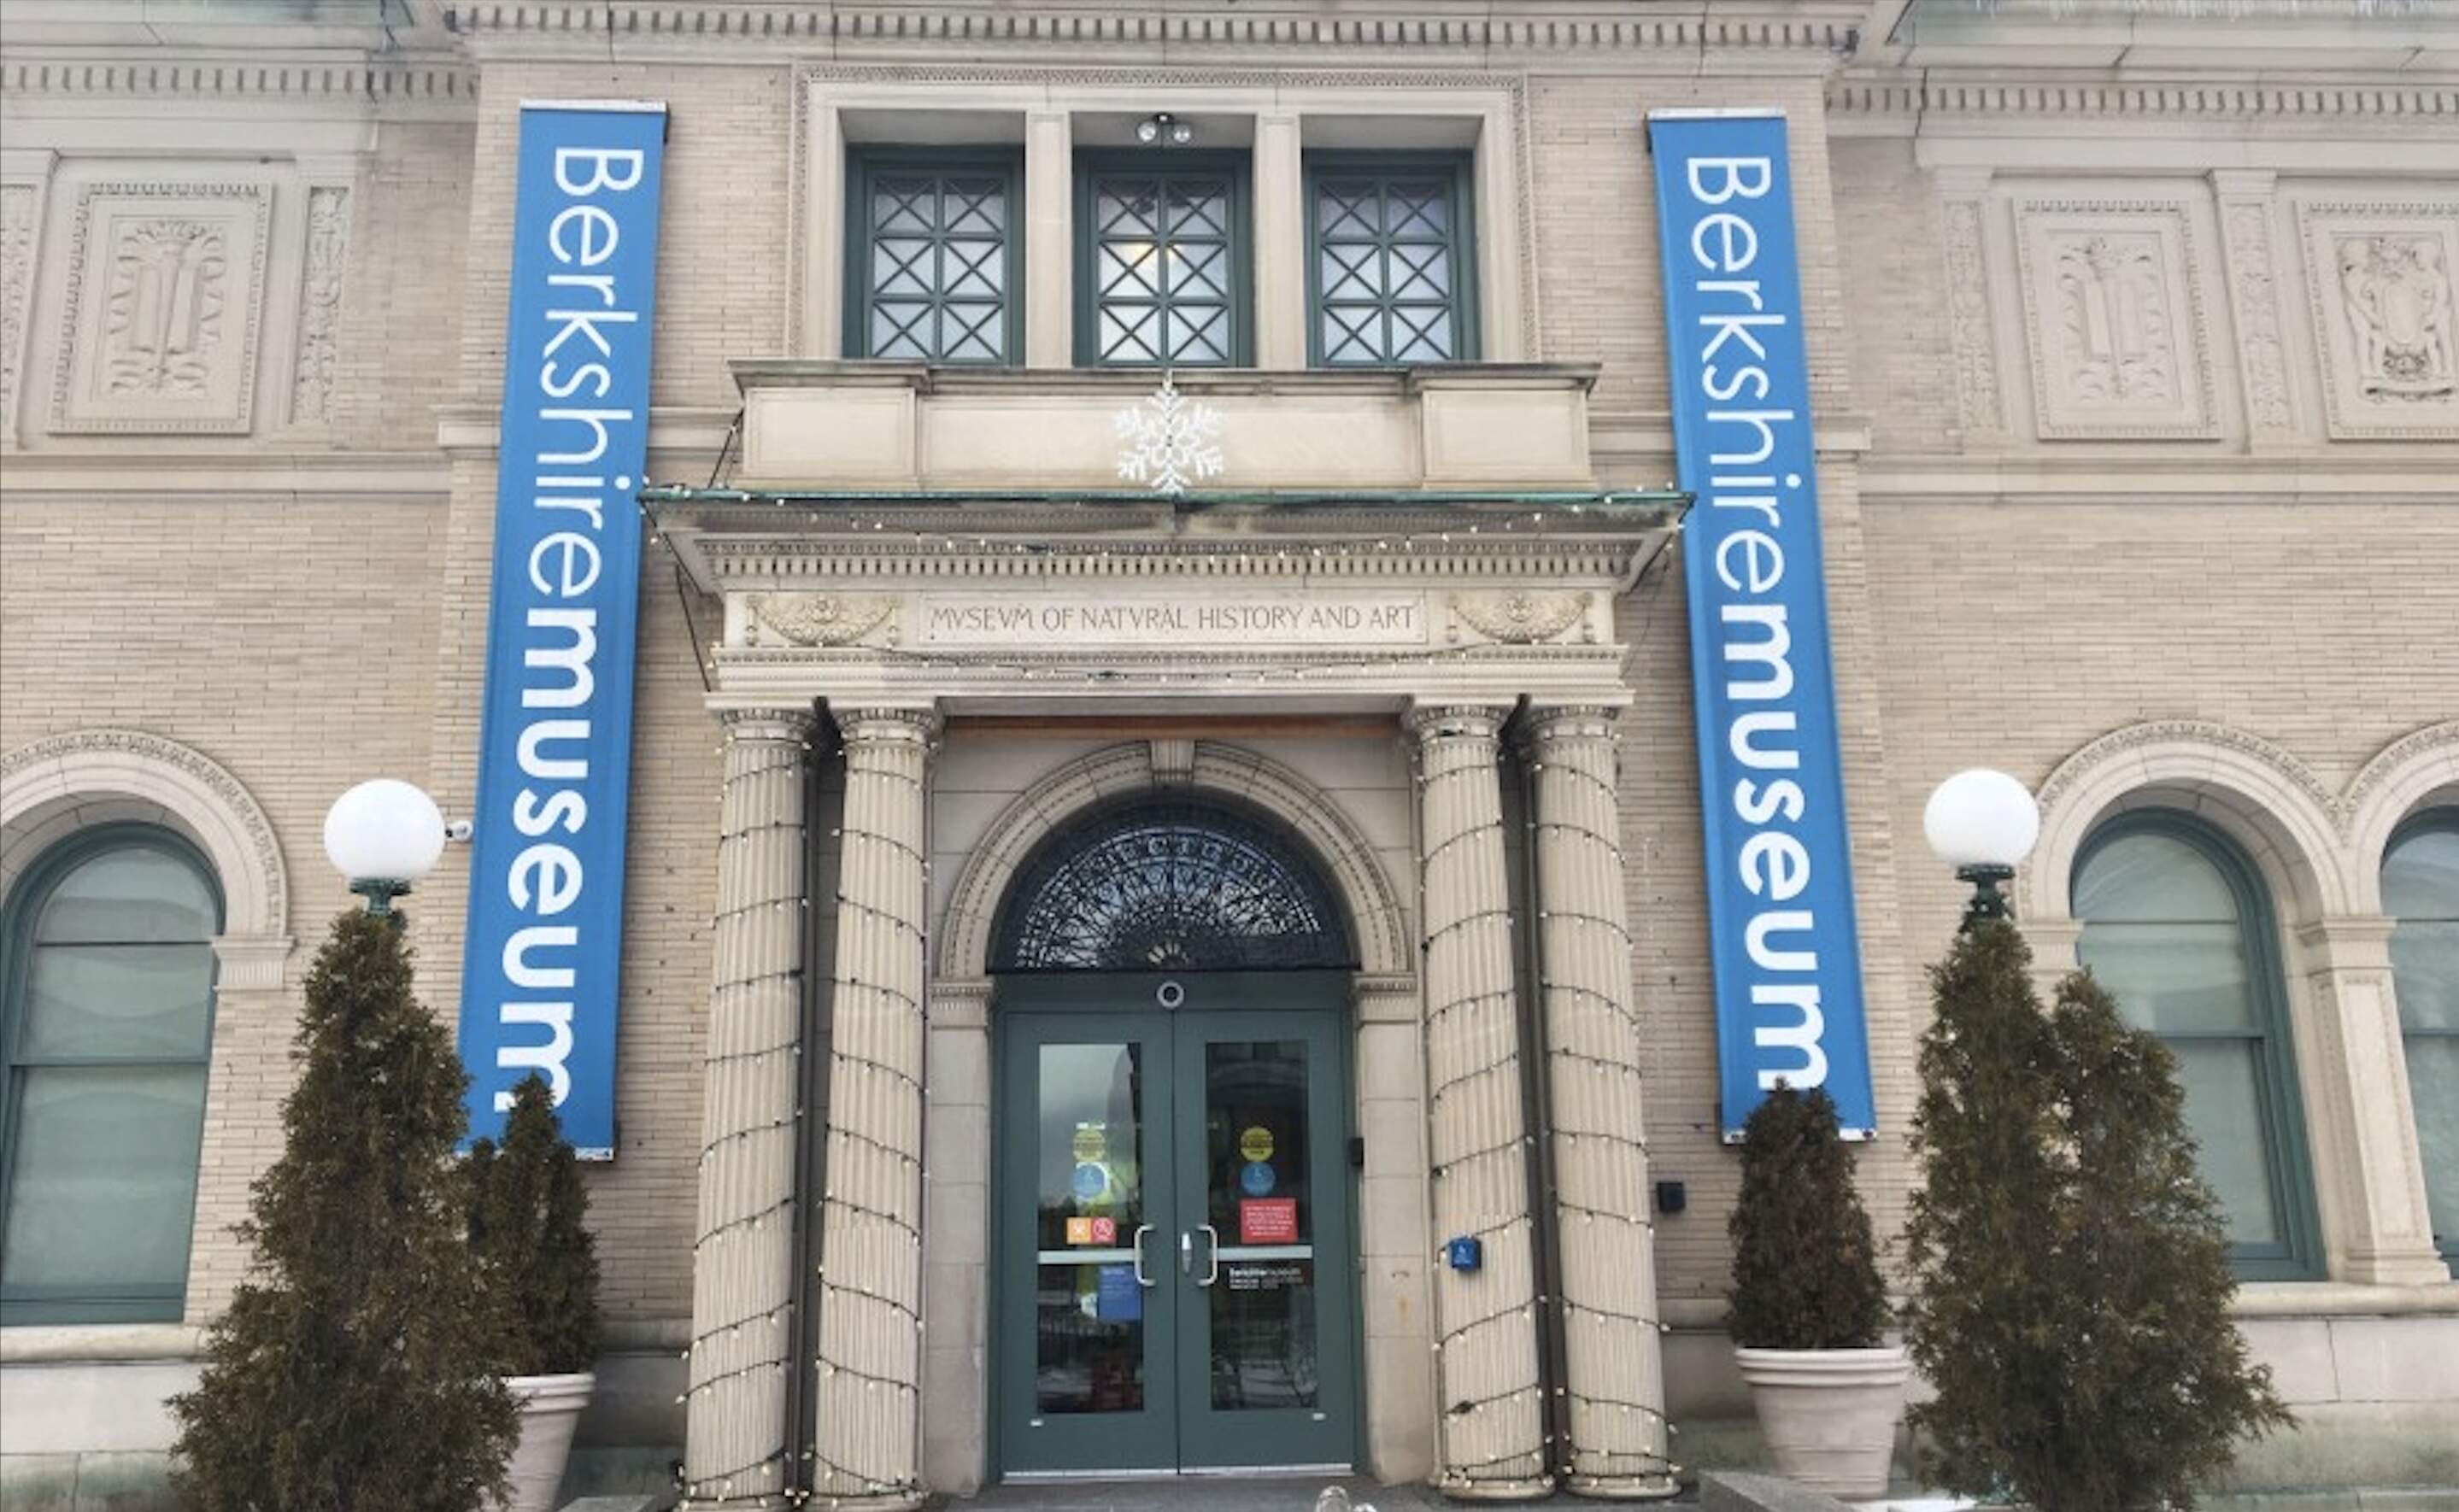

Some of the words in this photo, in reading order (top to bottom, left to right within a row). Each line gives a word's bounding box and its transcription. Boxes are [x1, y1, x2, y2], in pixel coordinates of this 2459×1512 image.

[1042, 606, 1075, 631] OF
[1081, 606, 1189, 630] NATVRAL
[1198, 605, 1304, 630] HISTORY
[1308, 606, 1361, 630] AND
[1369, 606, 1414, 630] ART
